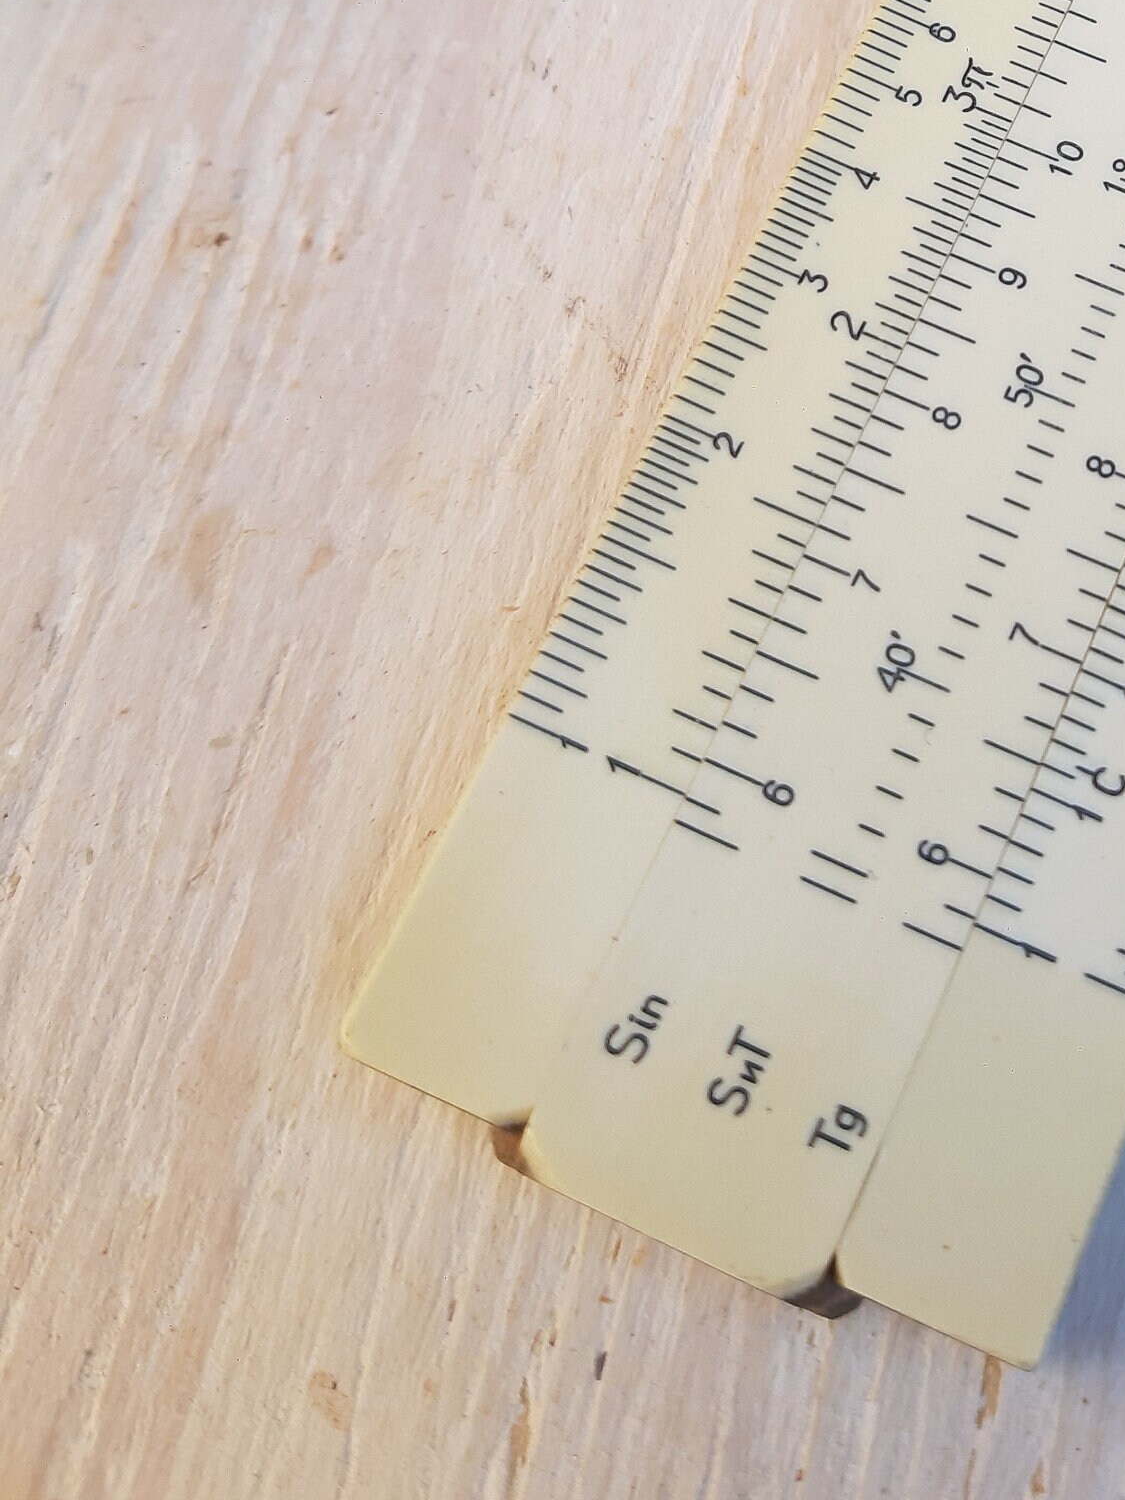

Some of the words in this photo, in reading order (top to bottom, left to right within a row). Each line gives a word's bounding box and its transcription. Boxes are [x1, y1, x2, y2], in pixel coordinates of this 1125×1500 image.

[929, 22, 956, 43] 6
[895, 85, 922, 106] 5
[1049, 141, 1084, 176] 10
[854, 167, 880, 189] 4
[797, 268, 828, 292] 3
[998, 266, 1027, 289] 9
[830, 310, 866, 340] 2
[931, 406, 961, 430] 8
[713, 431, 744, 458] 2
[1086, 455, 1116, 478] 8
[851, 568, 880, 592] 7
[1009, 622, 1040, 646] 7
[606, 754, 641, 776] 1
[761, 780, 795, 806] 6
[917, 840, 949, 865] 6
[604, 994, 668, 1064] Sin
[808, 1103, 868, 1151] Tg
